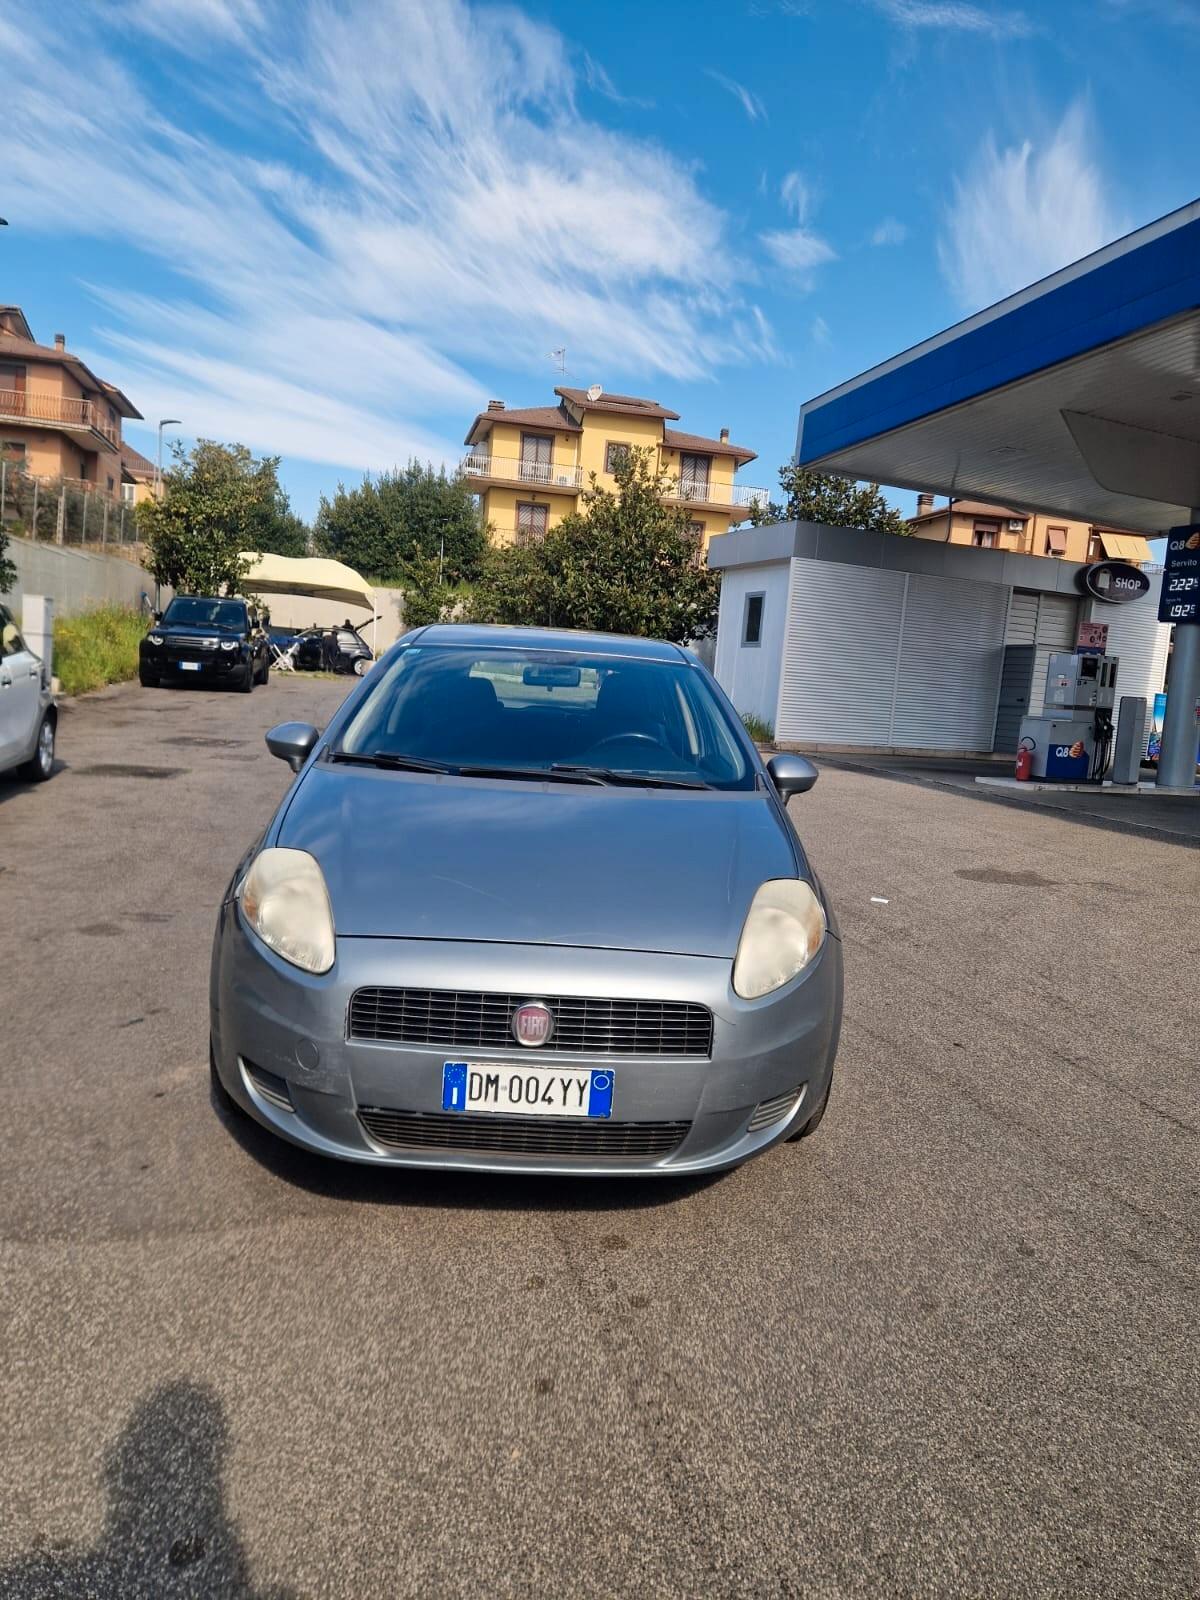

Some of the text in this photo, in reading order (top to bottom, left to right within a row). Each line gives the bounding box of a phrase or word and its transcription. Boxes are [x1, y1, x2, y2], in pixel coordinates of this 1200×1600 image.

[1170, 540, 1185, 550] Q8
[1115, 578, 1141, 590] SHOP
[1056, 747, 1069, 757] Q8
[521, 1015, 547, 1035] FIAT
